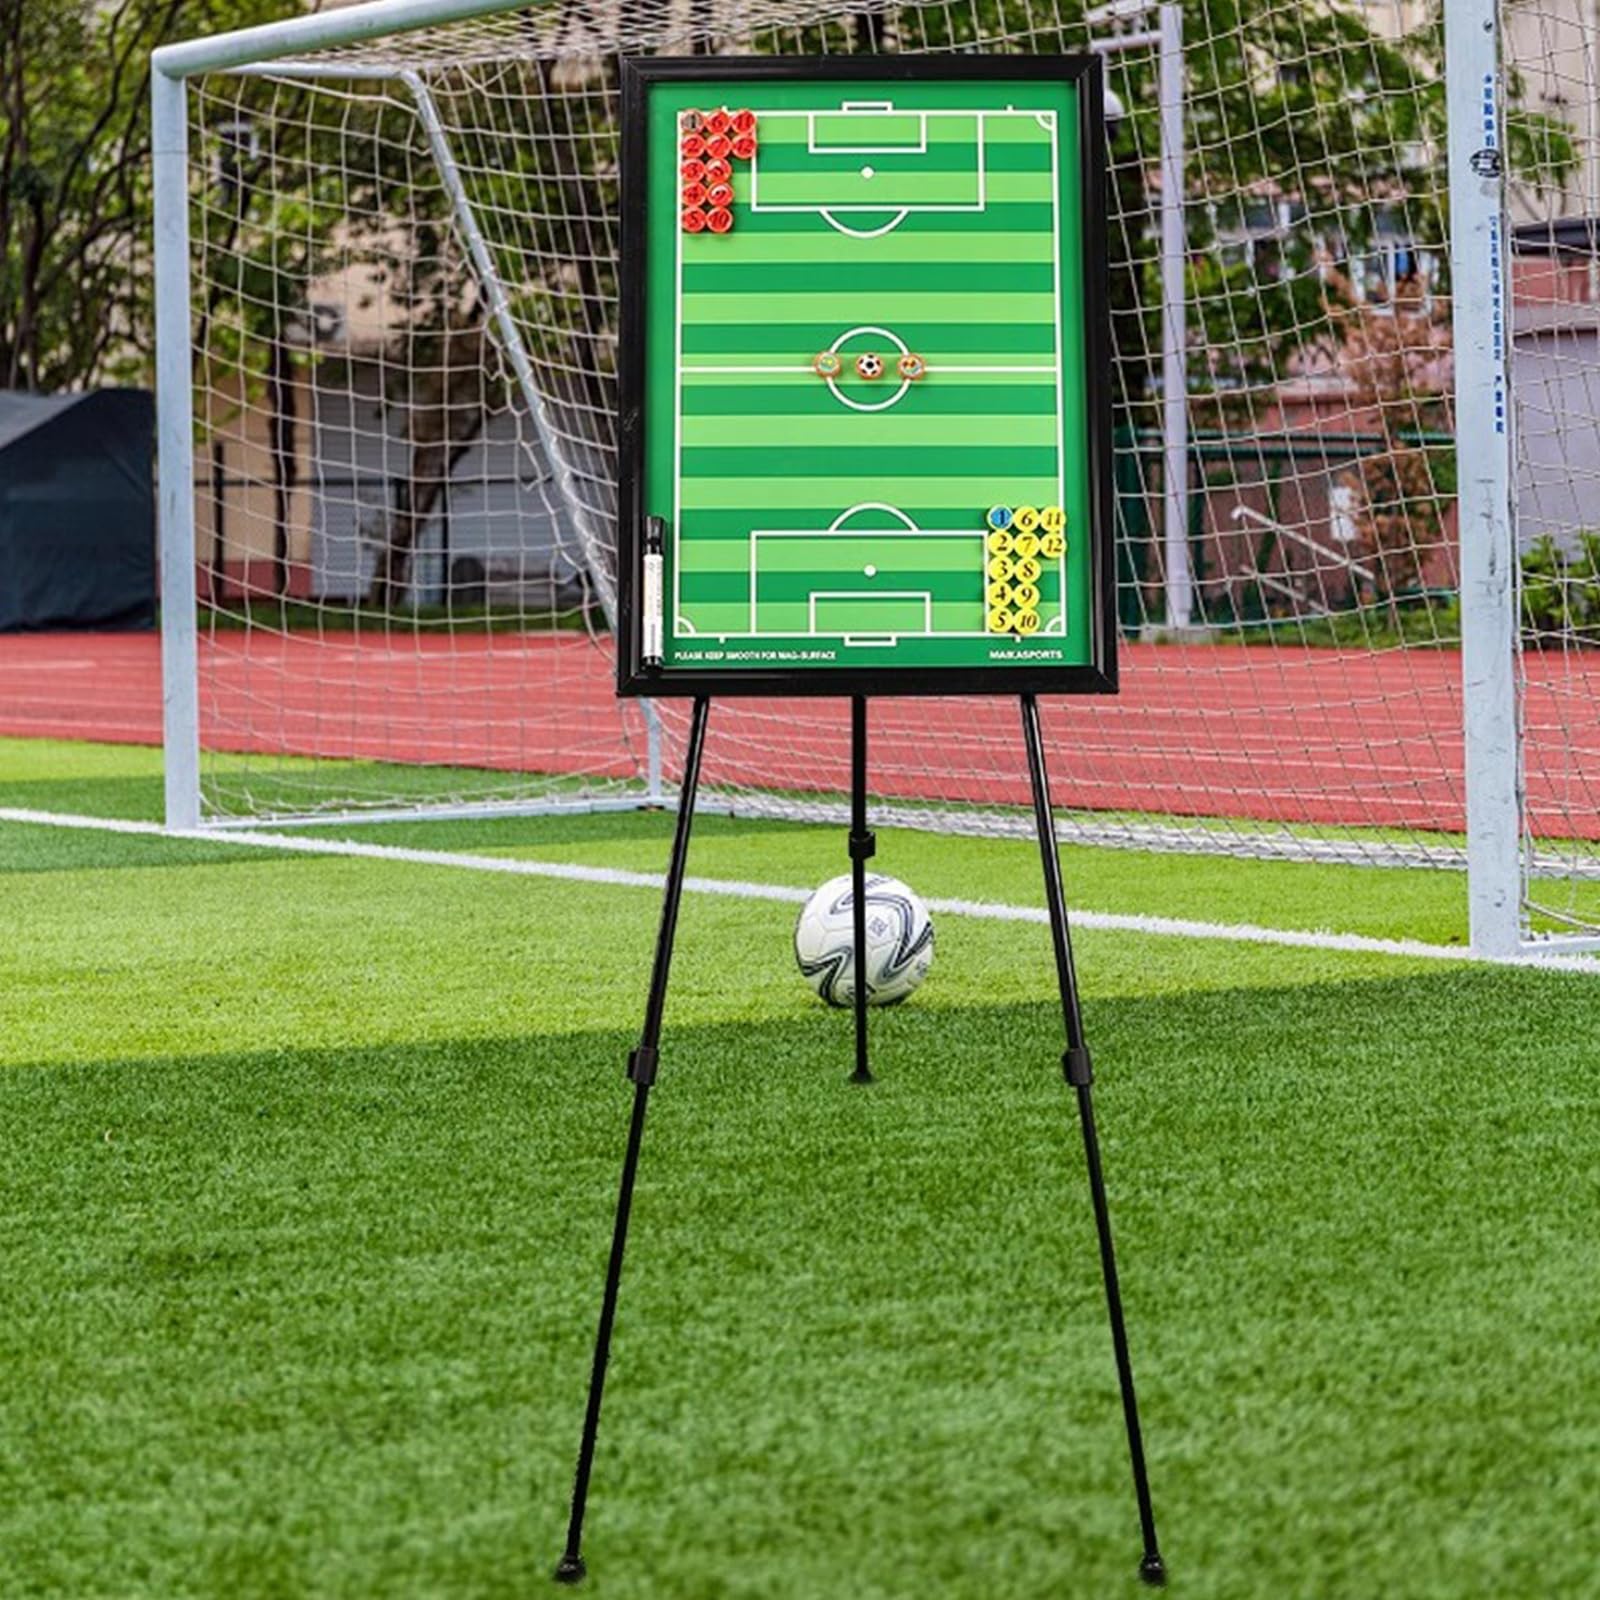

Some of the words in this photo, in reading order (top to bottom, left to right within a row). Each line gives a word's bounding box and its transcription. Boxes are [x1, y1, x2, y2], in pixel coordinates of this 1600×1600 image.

[686, 137, 699, 154] 2
[998, 509, 1006, 526] 1
[1021, 510, 1033, 526] 6
[1046, 511, 1061, 526] 11
[996, 533, 1008, 551] 2
[1022, 536, 1033, 553] 7
[1046, 538, 1062, 553] 12
[997, 560, 1008, 577] 3
[1022, 560, 1034, 578] 8
[995, 586, 1006, 601] 4
[1021, 586, 1033, 604] 9
[995, 611, 1007, 628] 5
[1020, 613, 1037, 629] 10
[674, 650, 702, 660] PLEASE
[704, 650, 723, 660] KEEP
[726, 650, 760, 660] SMOOTH
[761, 650, 776, 660] FOR
